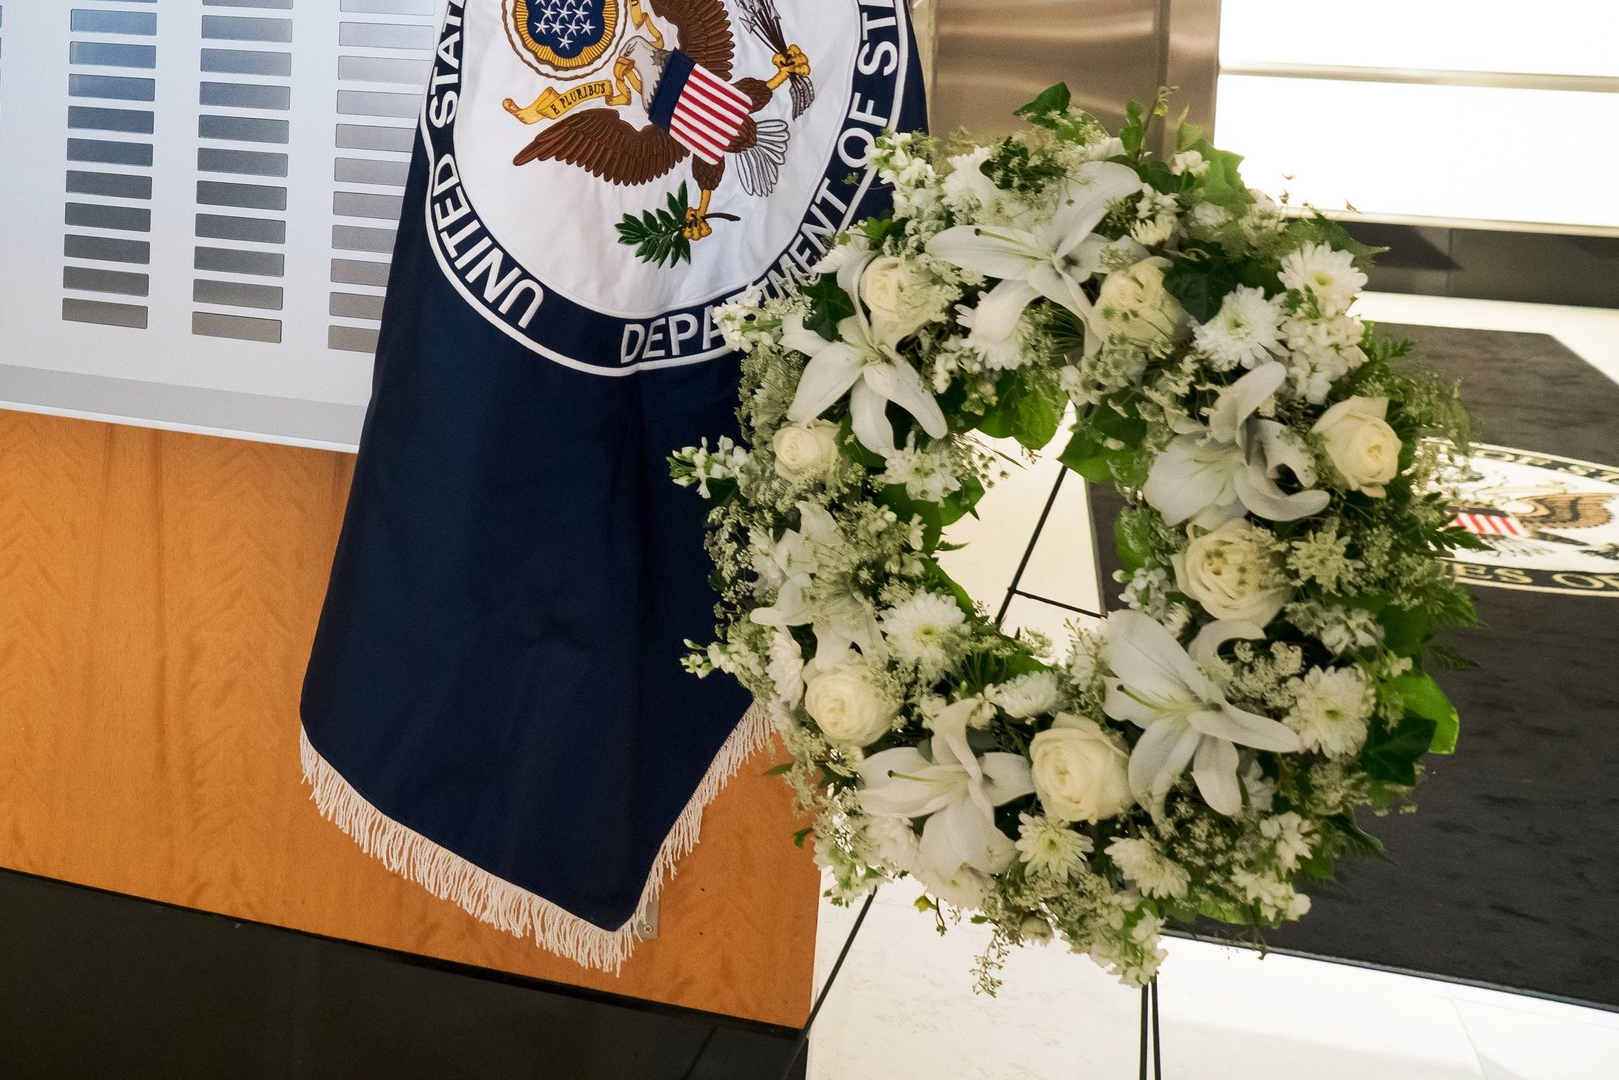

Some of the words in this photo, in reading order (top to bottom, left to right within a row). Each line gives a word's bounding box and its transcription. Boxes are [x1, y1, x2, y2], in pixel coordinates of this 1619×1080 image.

[550, 99, 559, 115] E
[562, 80, 607, 109] PLURIBUS
[433, 154, 545, 329] UNITED
[620, 177, 848, 364] DEPATMENT
[837, 98, 889, 168] OF
